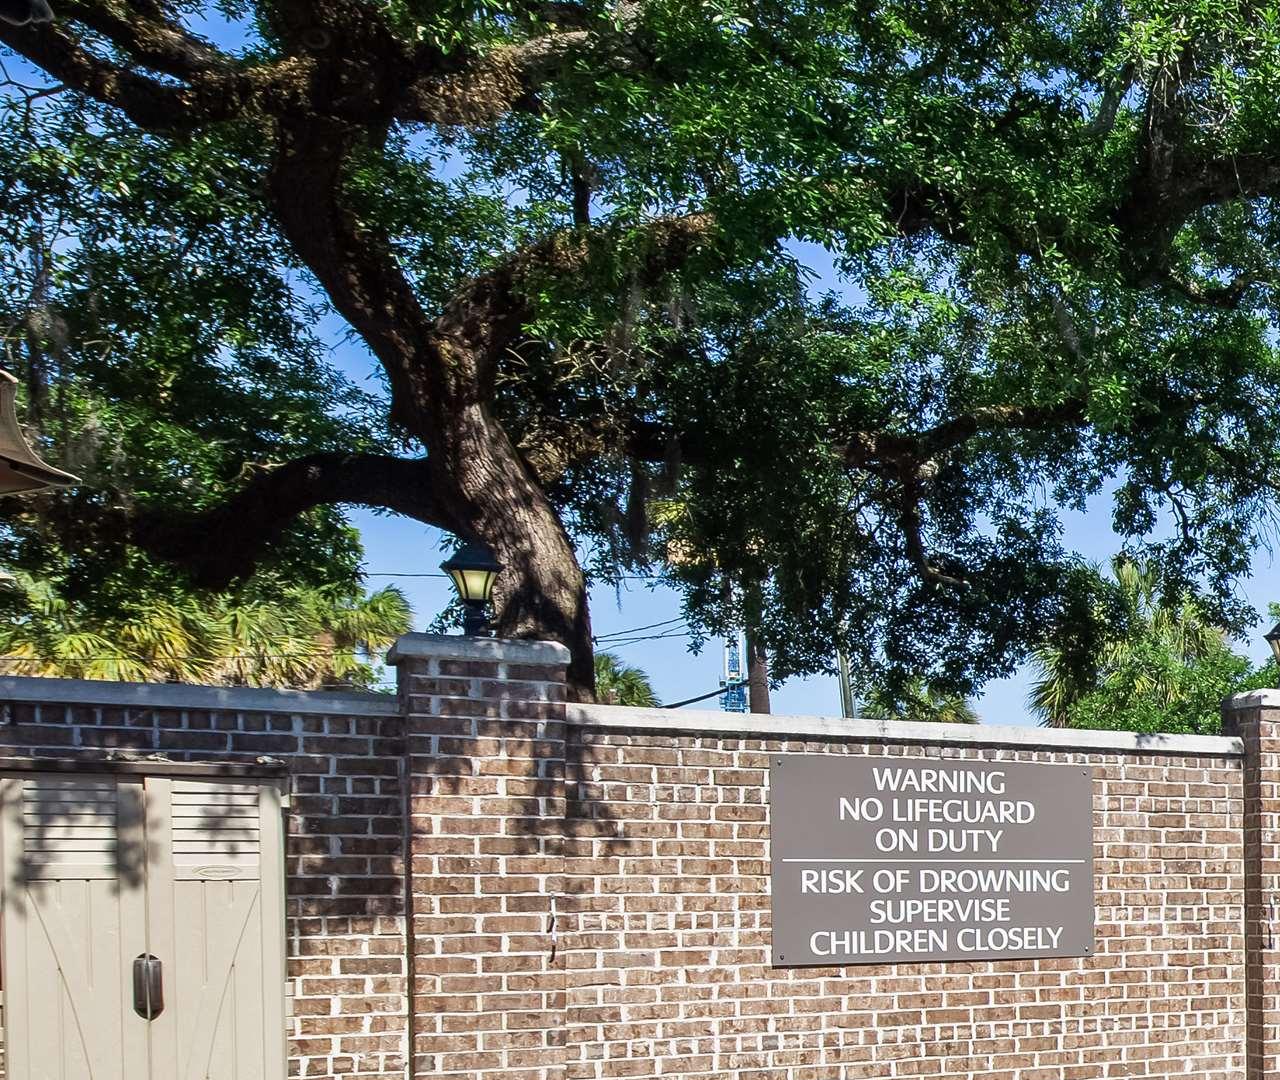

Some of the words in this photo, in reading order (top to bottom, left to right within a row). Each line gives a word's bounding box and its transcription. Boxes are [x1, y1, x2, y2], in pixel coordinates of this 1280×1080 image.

[872, 767, 1006, 794] WARNING
[839, 797, 884, 822] NO
[892, 798, 1036, 824] LIFEGUARD
[875, 828, 919, 853] ON
[928, 829, 1004, 853] DUTY
[800, 869, 865, 894] RISK
[872, 869, 914, 894] OF
[919, 869, 1071, 894] DROWNING
[869, 898, 1011, 924] SUPERVISE
[809, 929, 948, 956] CHILDREN
[956, 926, 1064, 953] CLOSELY
